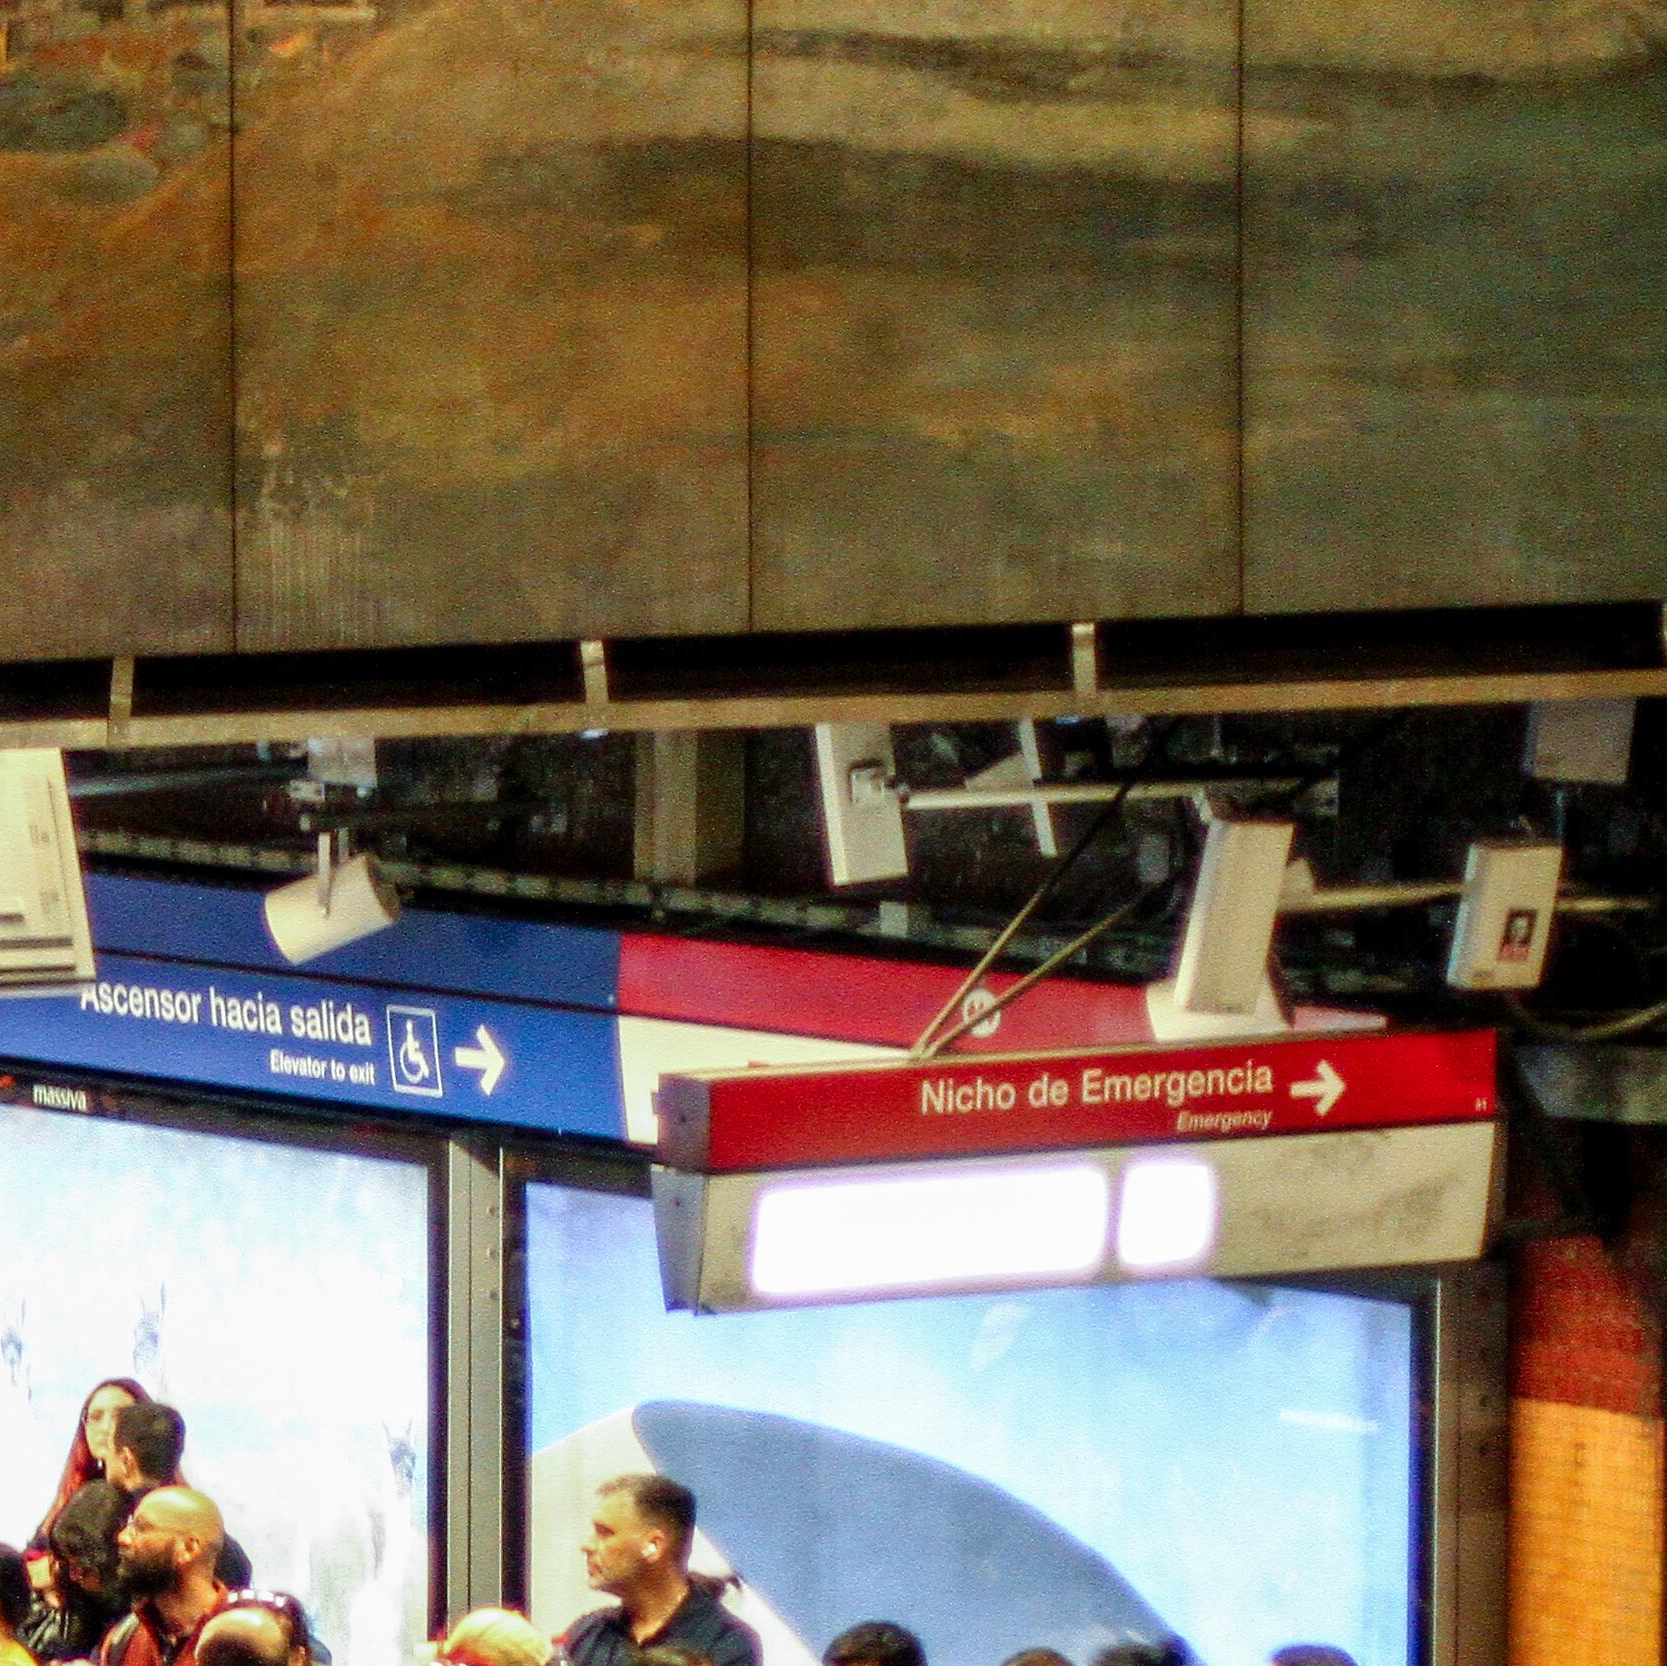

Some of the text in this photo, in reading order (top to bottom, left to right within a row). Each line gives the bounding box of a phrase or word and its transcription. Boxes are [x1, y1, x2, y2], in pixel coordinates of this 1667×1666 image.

[79, 982, 372, 1046] Ascensor hacia salida
[269, 1051, 376, 1086] Elevator to exit
[920, 1058, 1276, 1116] Nicho de Emergencia
[1175, 1106, 1273, 1133] Emergency
